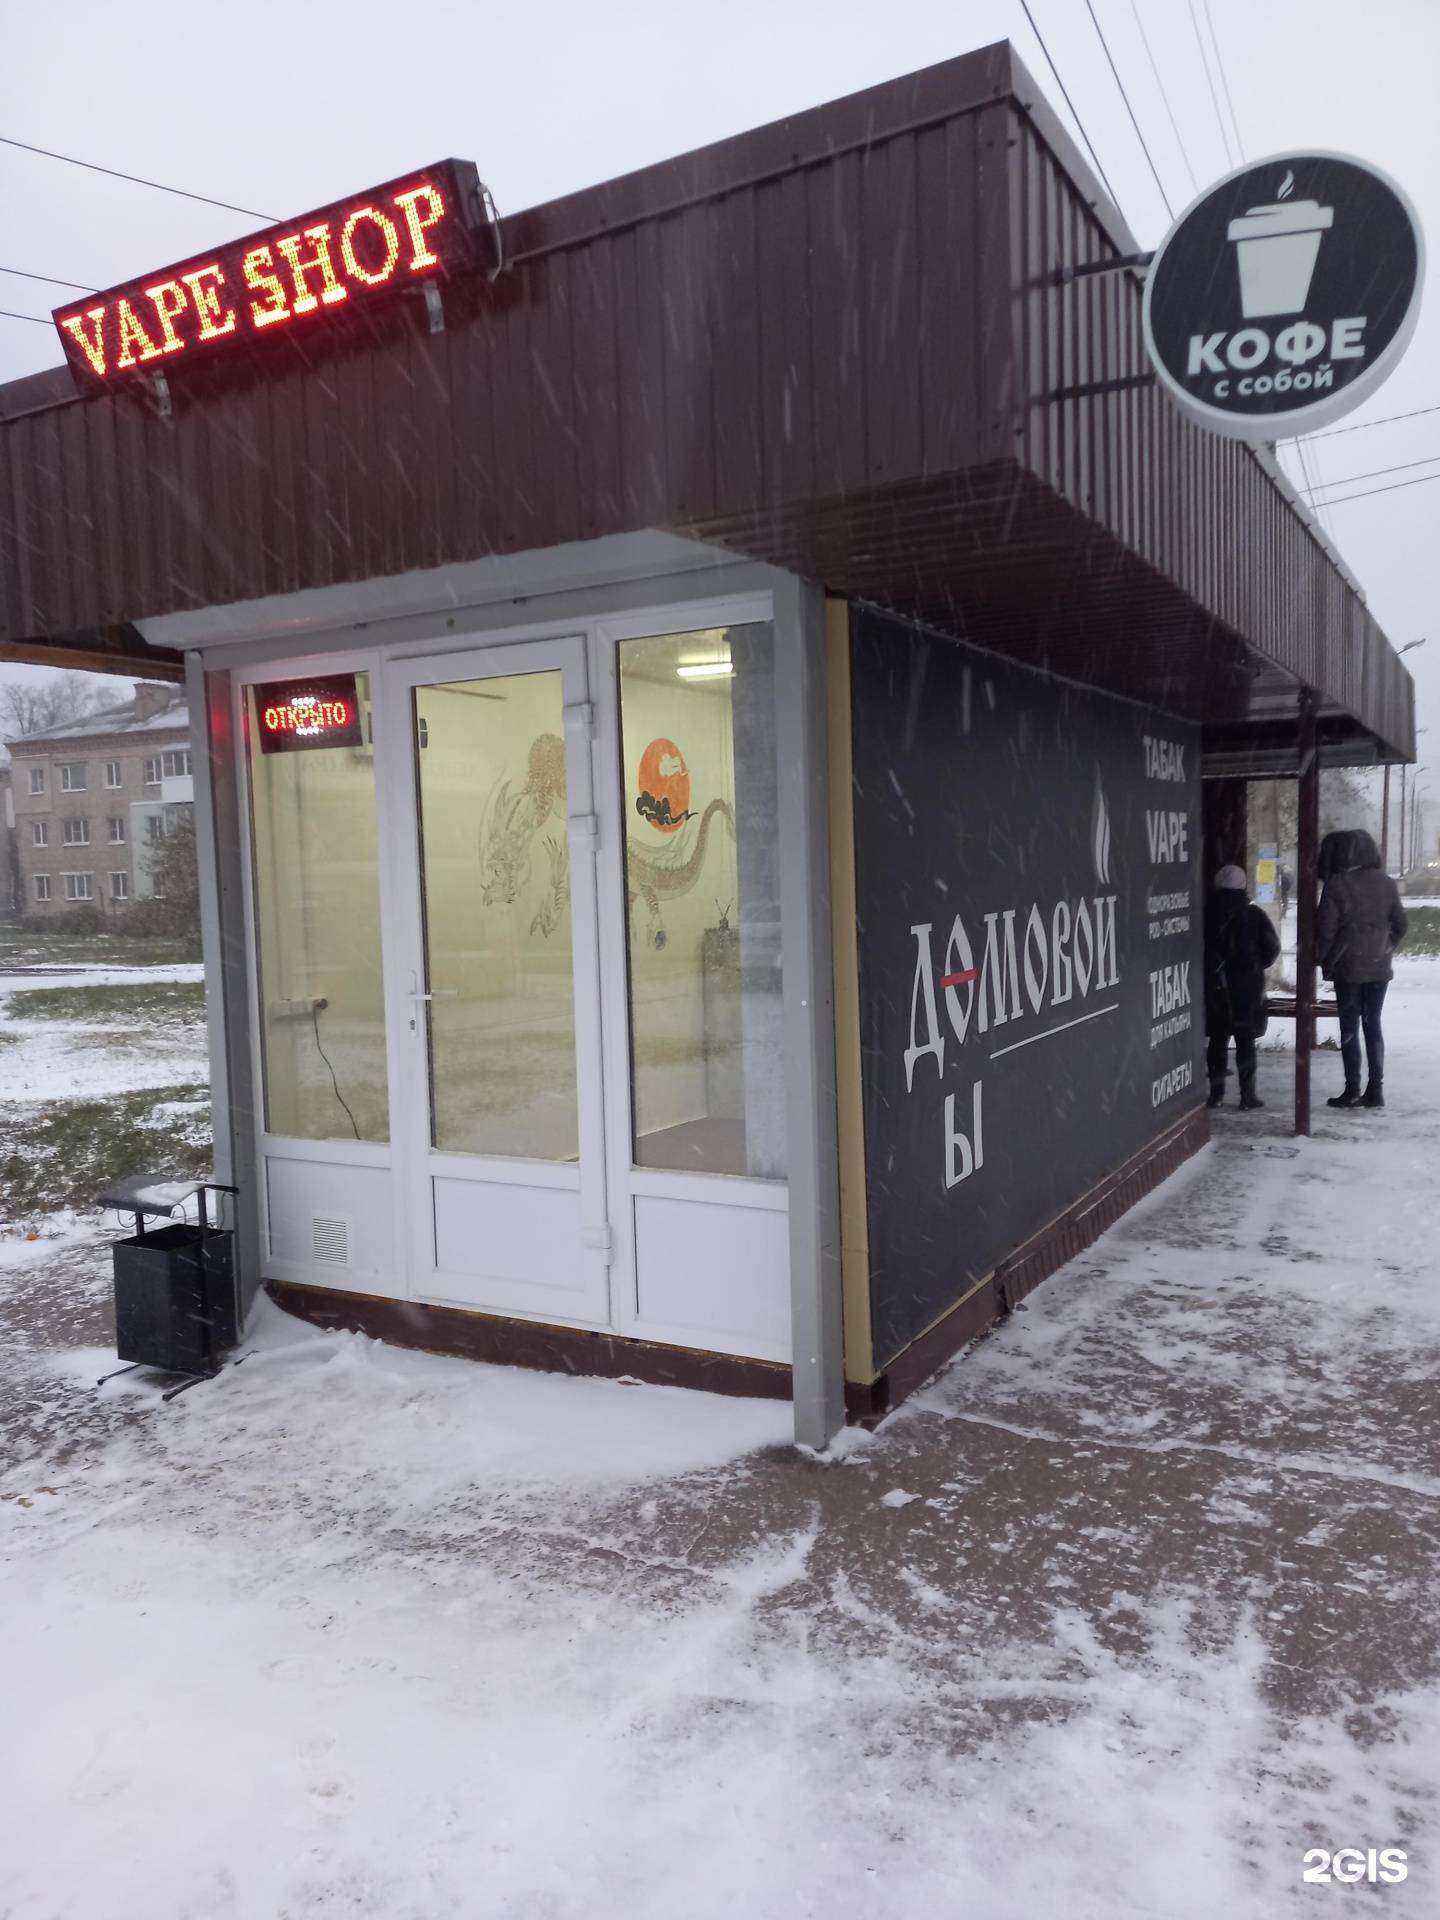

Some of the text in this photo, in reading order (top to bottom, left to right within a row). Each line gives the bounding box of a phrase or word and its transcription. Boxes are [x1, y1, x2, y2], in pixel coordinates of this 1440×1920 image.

[61, 184, 446, 377] VAPE SHOP
[1187, 315, 1368, 376] КОФЕ
[1213, 363, 1335, 398] с собой
[265, 701, 347, 730] ОТКРЫТО
[1142, 734, 1187, 783] ТАБАК
[1146, 809, 1189, 864] VAPE
[1149, 960, 1191, 1020] ТАБАК
[944, 1079, 984, 1190] Ы
